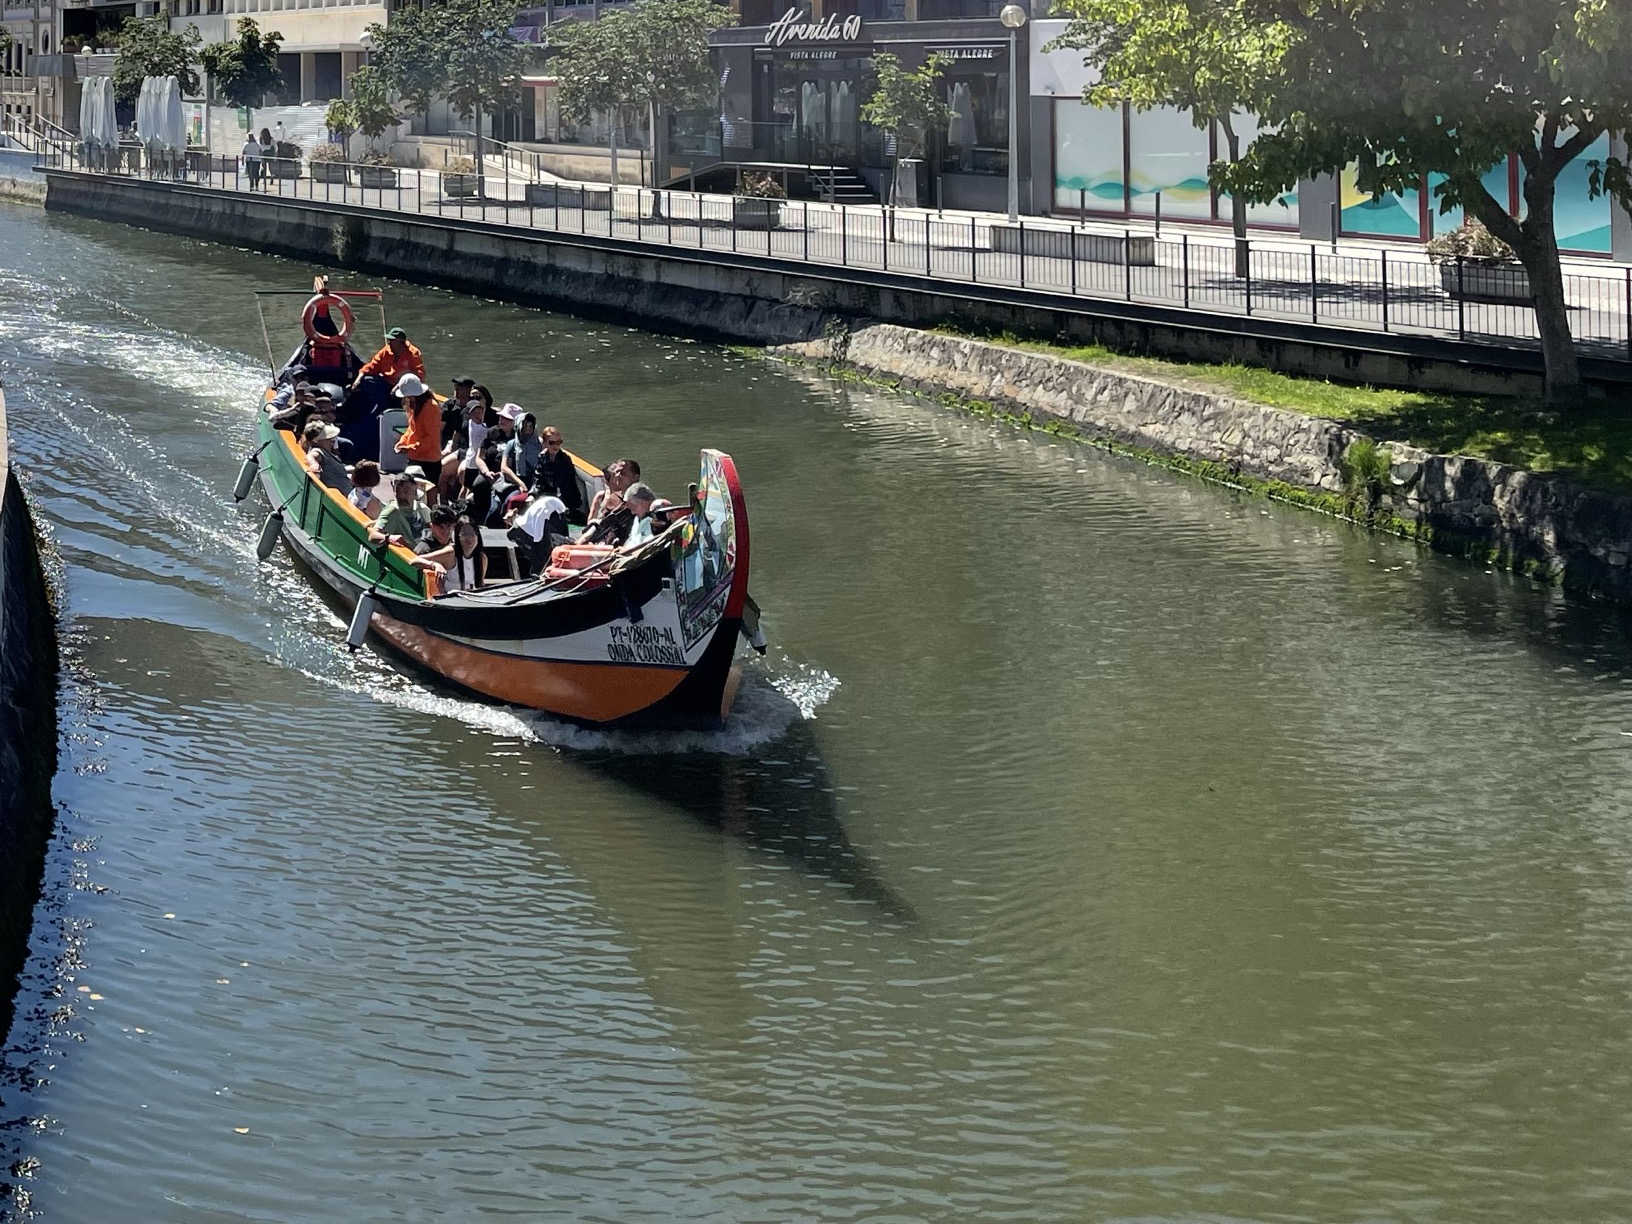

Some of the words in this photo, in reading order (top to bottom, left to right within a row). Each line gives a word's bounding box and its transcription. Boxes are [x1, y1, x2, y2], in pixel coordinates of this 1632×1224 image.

[764, 6, 841, 47] Avenida
[842, 14, 861, 41] 60
[790, 51, 809, 60] VISTA
[811, 51, 838, 59] ALEGRE
[961, 49, 994, 59] ALEGRE
[607, 644, 637, 661] ONDA
[637, 645, 687, 664] COLOSSAL
